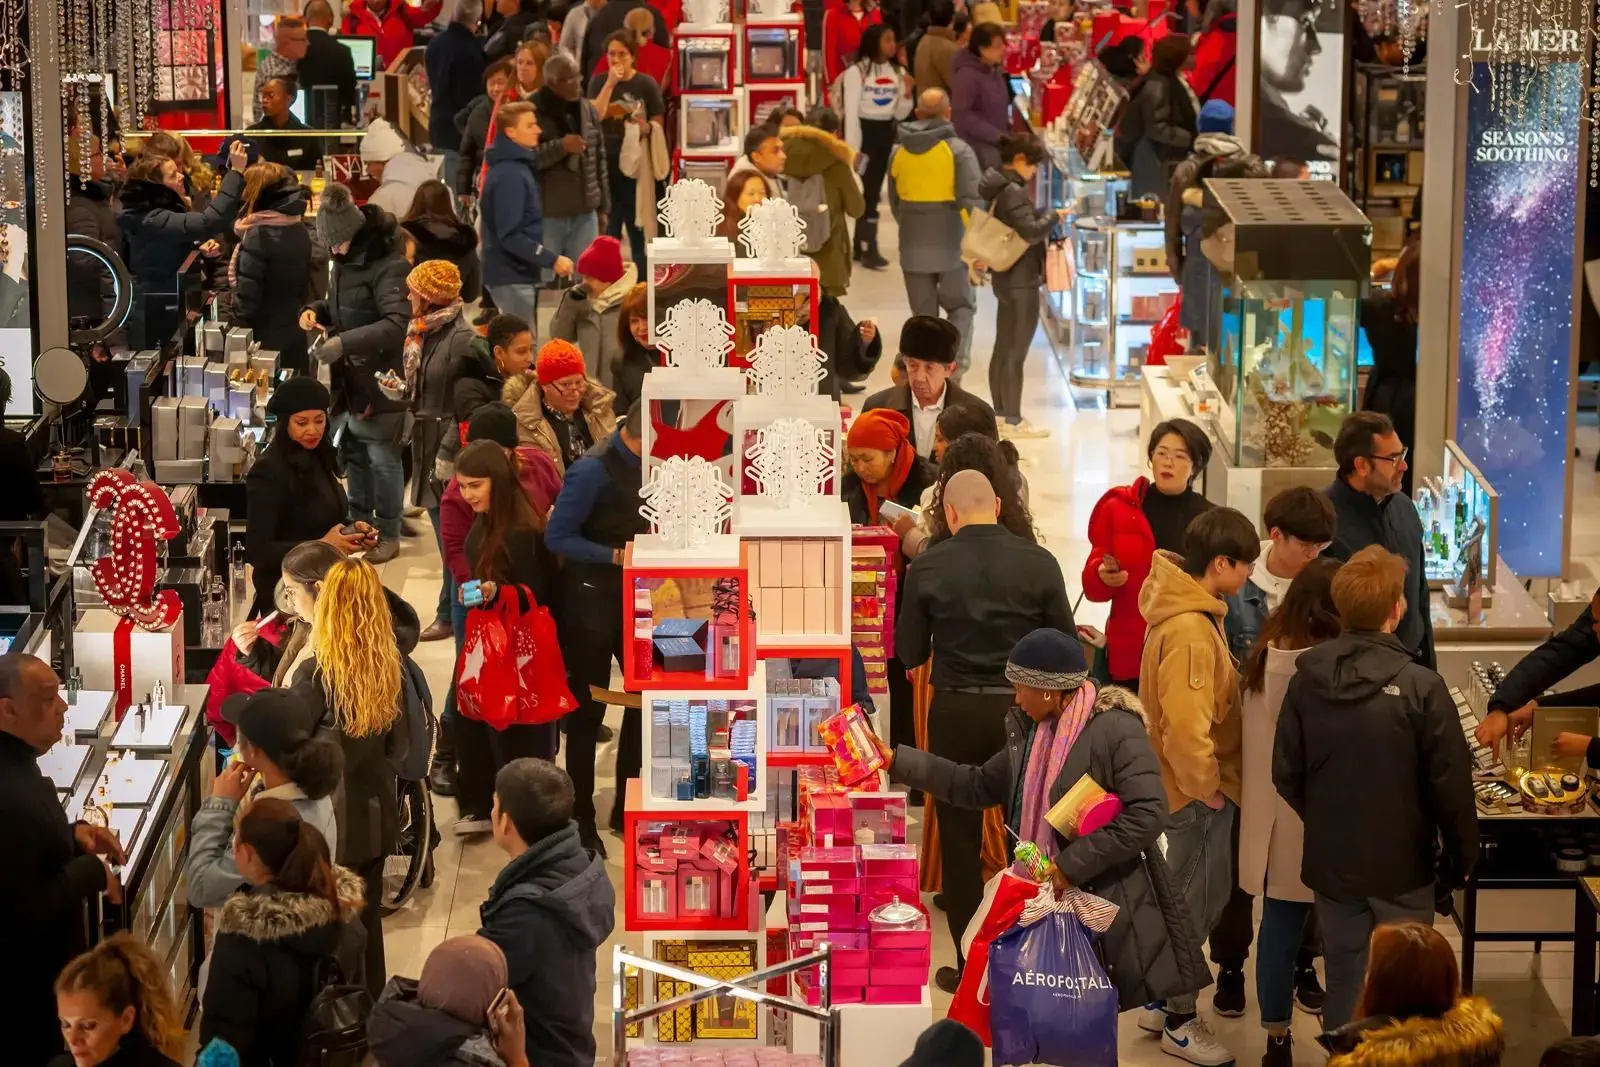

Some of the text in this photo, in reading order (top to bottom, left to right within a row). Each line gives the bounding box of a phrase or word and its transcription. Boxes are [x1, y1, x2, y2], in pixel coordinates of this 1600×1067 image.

[1473, 29, 1580, 53] LA MER
[1482, 131, 1565, 146] SEASON'S
[1476, 147, 1568, 162] SOOTHING
